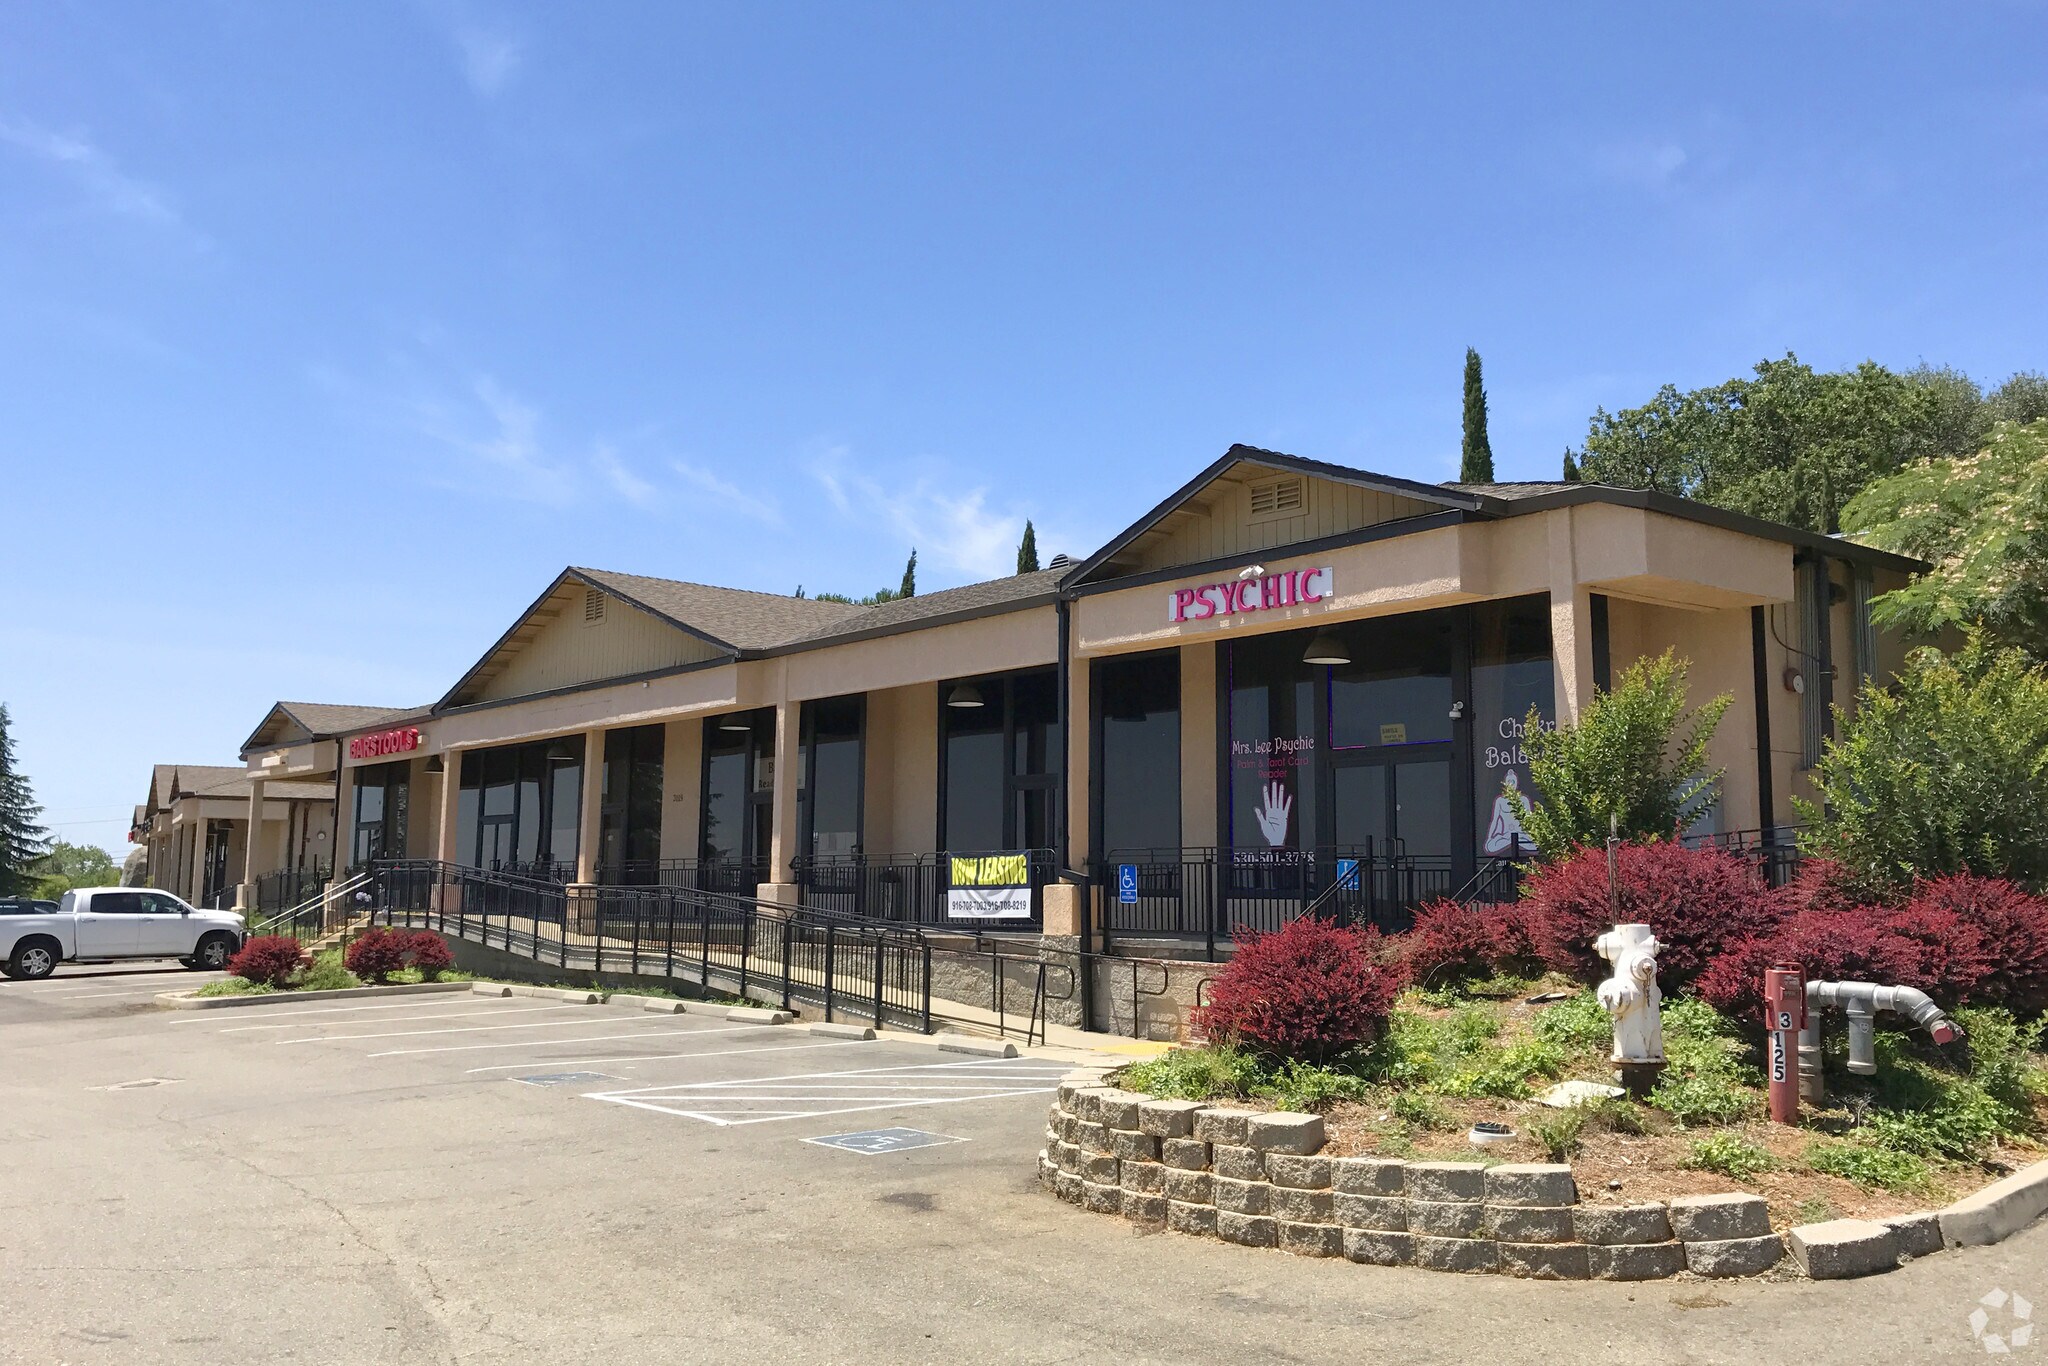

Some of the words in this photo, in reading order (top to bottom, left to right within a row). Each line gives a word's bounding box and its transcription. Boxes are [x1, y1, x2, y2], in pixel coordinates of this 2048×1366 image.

[1175, 567, 1322, 622] PSYCHIC
[1499, 717, 1555, 739] Chkr
[350, 728, 418, 759] BARSTOOLS
[1232, 740, 1252, 755] Mrs.
[1255, 739, 1272, 755] Lee
[1274, 736, 1315, 755] Psychic
[1237, 760, 1255, 769] Palm
[1267, 758, 1285, 767] Tarot
[1288, 756, 1309, 766] Card
[1258, 769, 1287, 778] Reader
[951, 857, 977, 886] NOW
[978, 854, 1027, 886] LEASING
